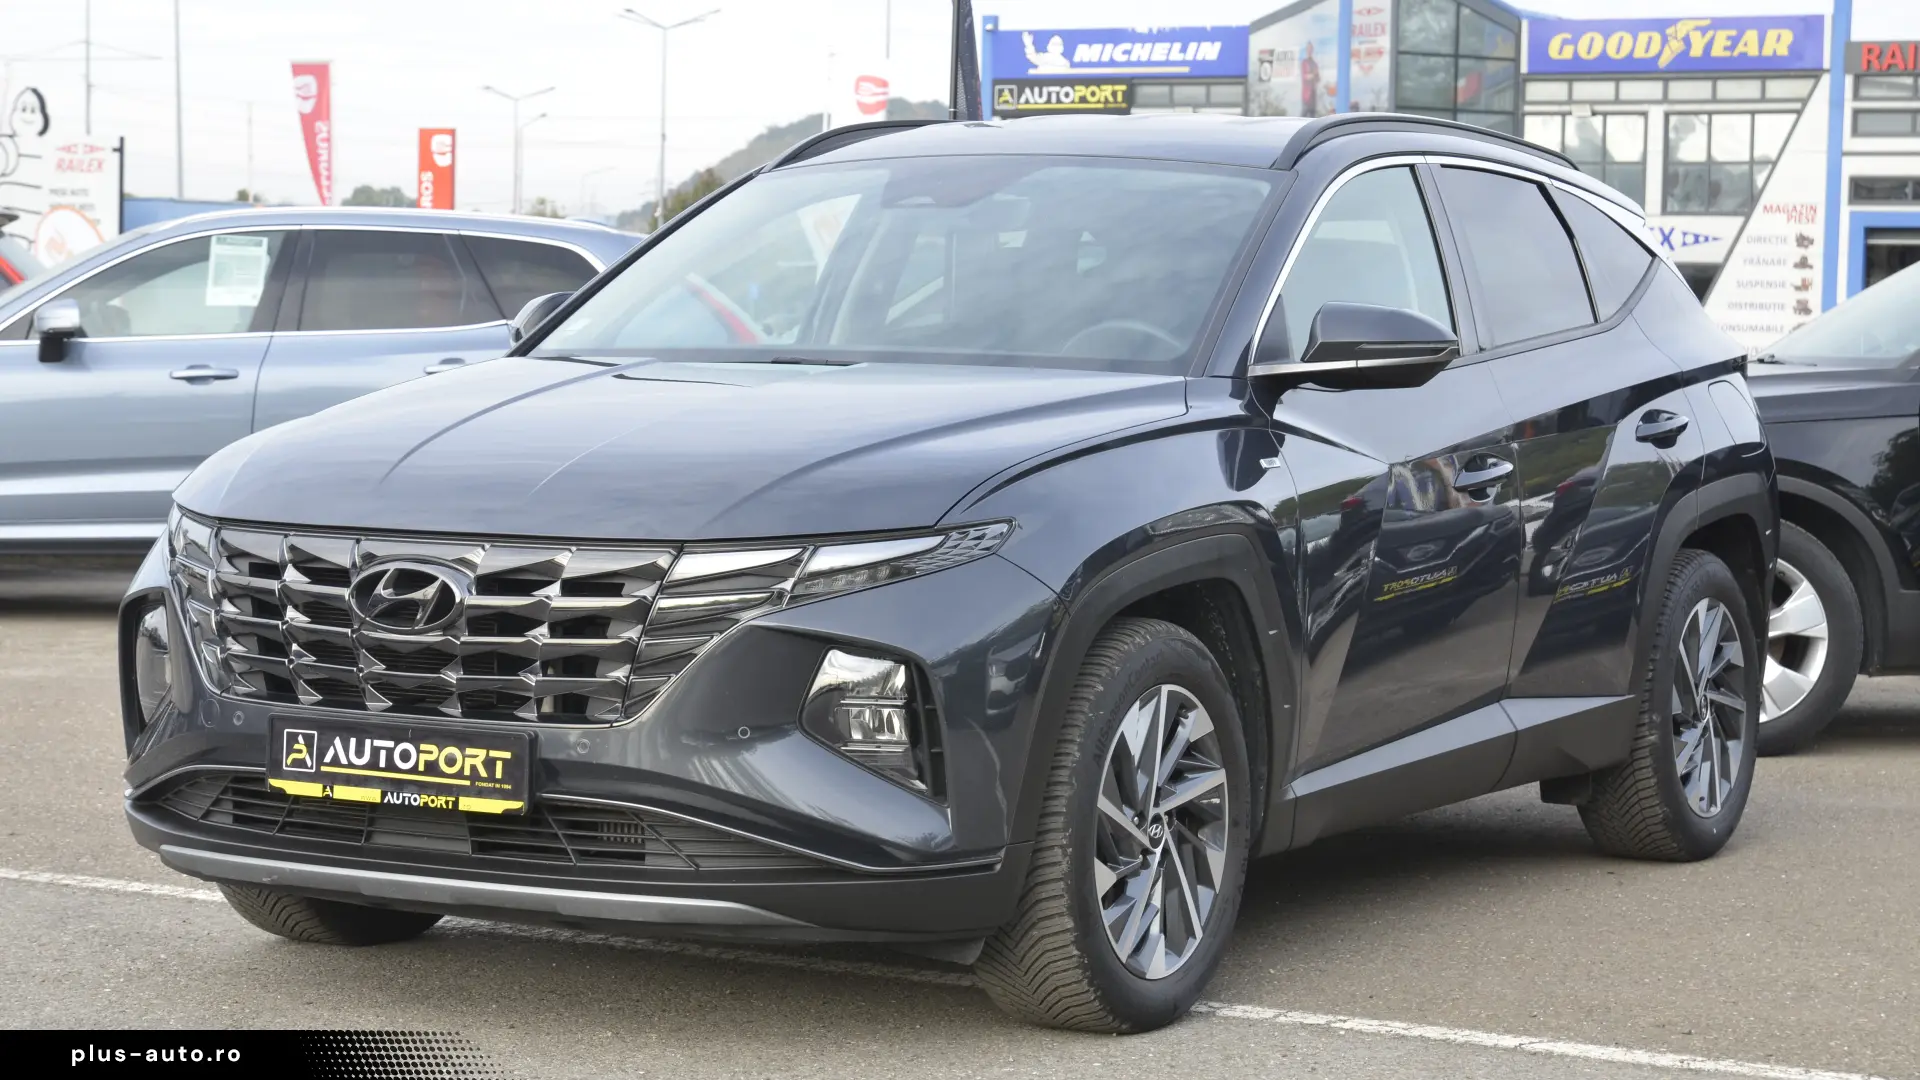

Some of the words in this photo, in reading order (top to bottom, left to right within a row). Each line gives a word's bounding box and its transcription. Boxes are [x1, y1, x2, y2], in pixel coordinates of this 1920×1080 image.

[1351, 22, 1387, 38] RAILEX
[1073, 41, 1222, 63] MICHELIN
[1019, 84, 1128, 104] AUTOPORT
[56, 157, 105, 173] RAILEX
[1763, 203, 1818, 215] MAGAZIN
[1786, 213, 1817, 225] PIESE
[323, 735, 512, 779] AUTOPORT
[383, 791, 456, 809] AUTOPORT
